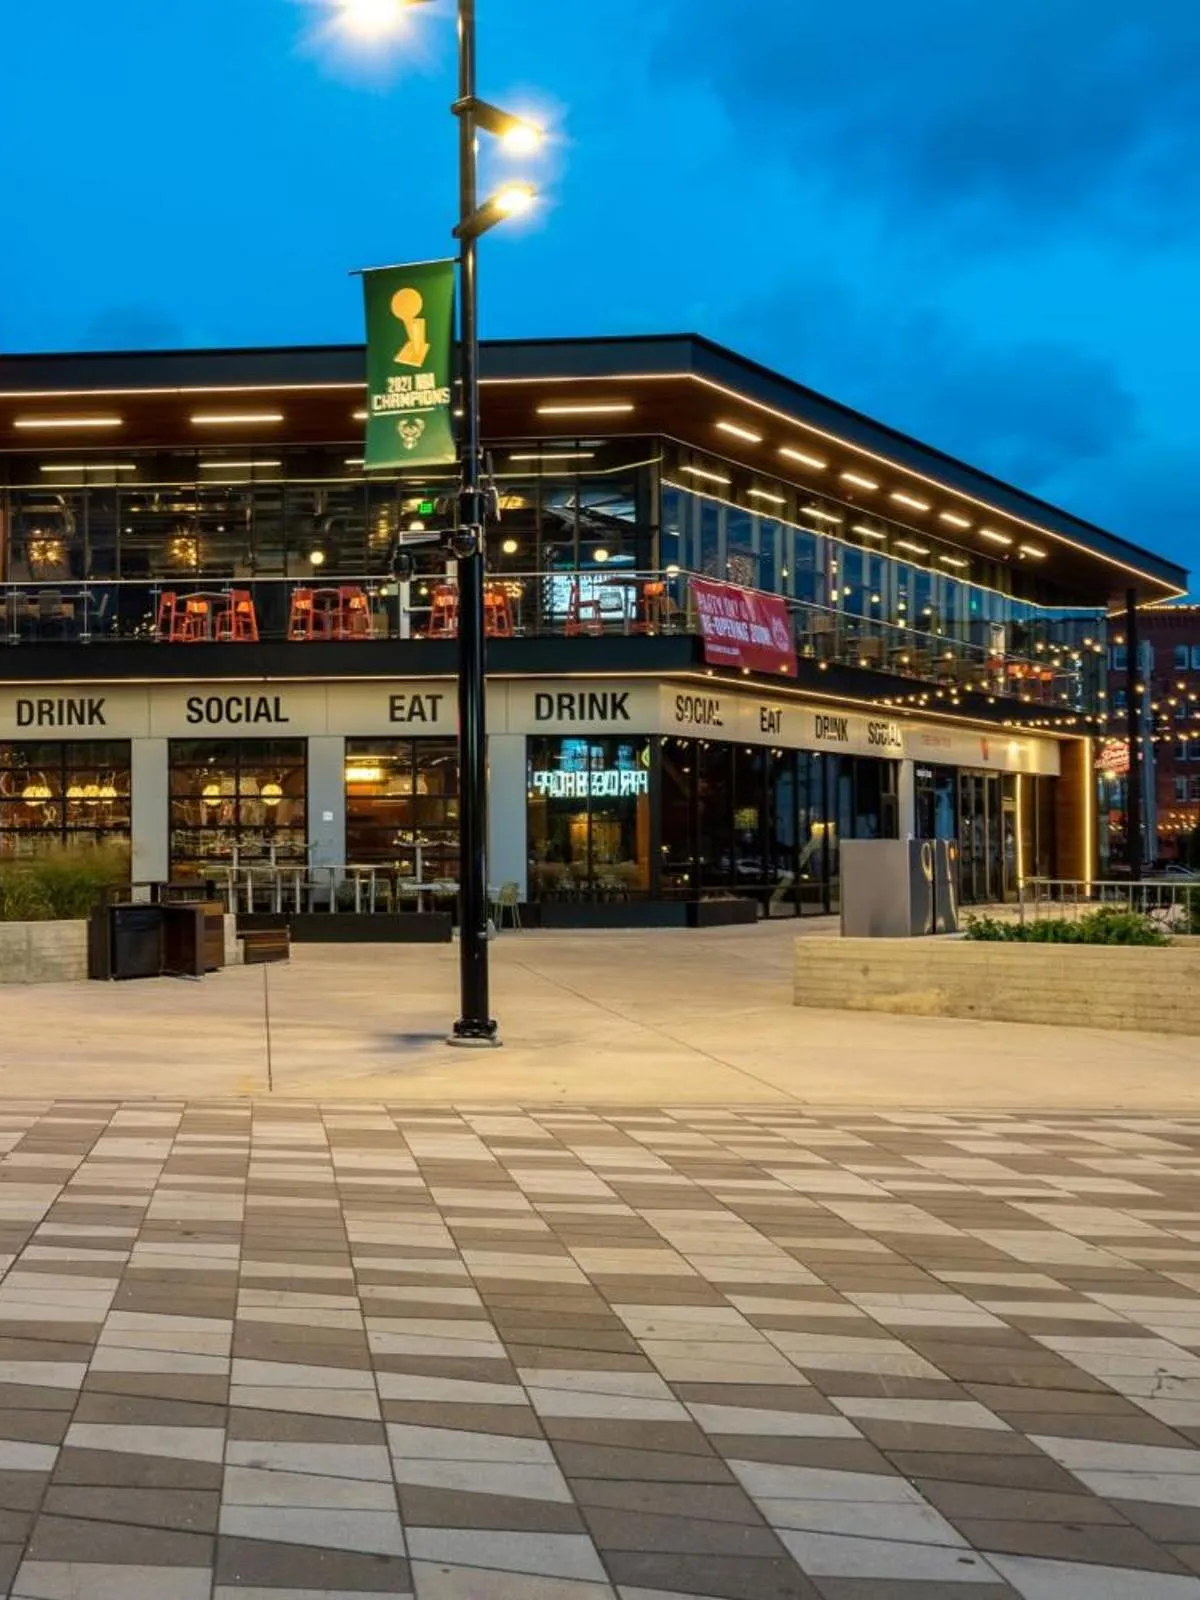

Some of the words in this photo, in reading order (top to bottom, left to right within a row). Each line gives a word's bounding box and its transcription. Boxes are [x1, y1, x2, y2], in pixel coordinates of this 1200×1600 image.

[387, 375, 412, 393] 2021
[373, 386, 451, 411] CHAMPIONS
[16, 698, 107, 726] DRINK
[186, 696, 289, 723] SOCIAL
[389, 695, 443, 722] EAT
[534, 692, 631, 721] DRINK
[676, 694, 723, 727] SOCIAL
[760, 706, 783, 734] EAT
[815, 714, 849, 742] DRINK
